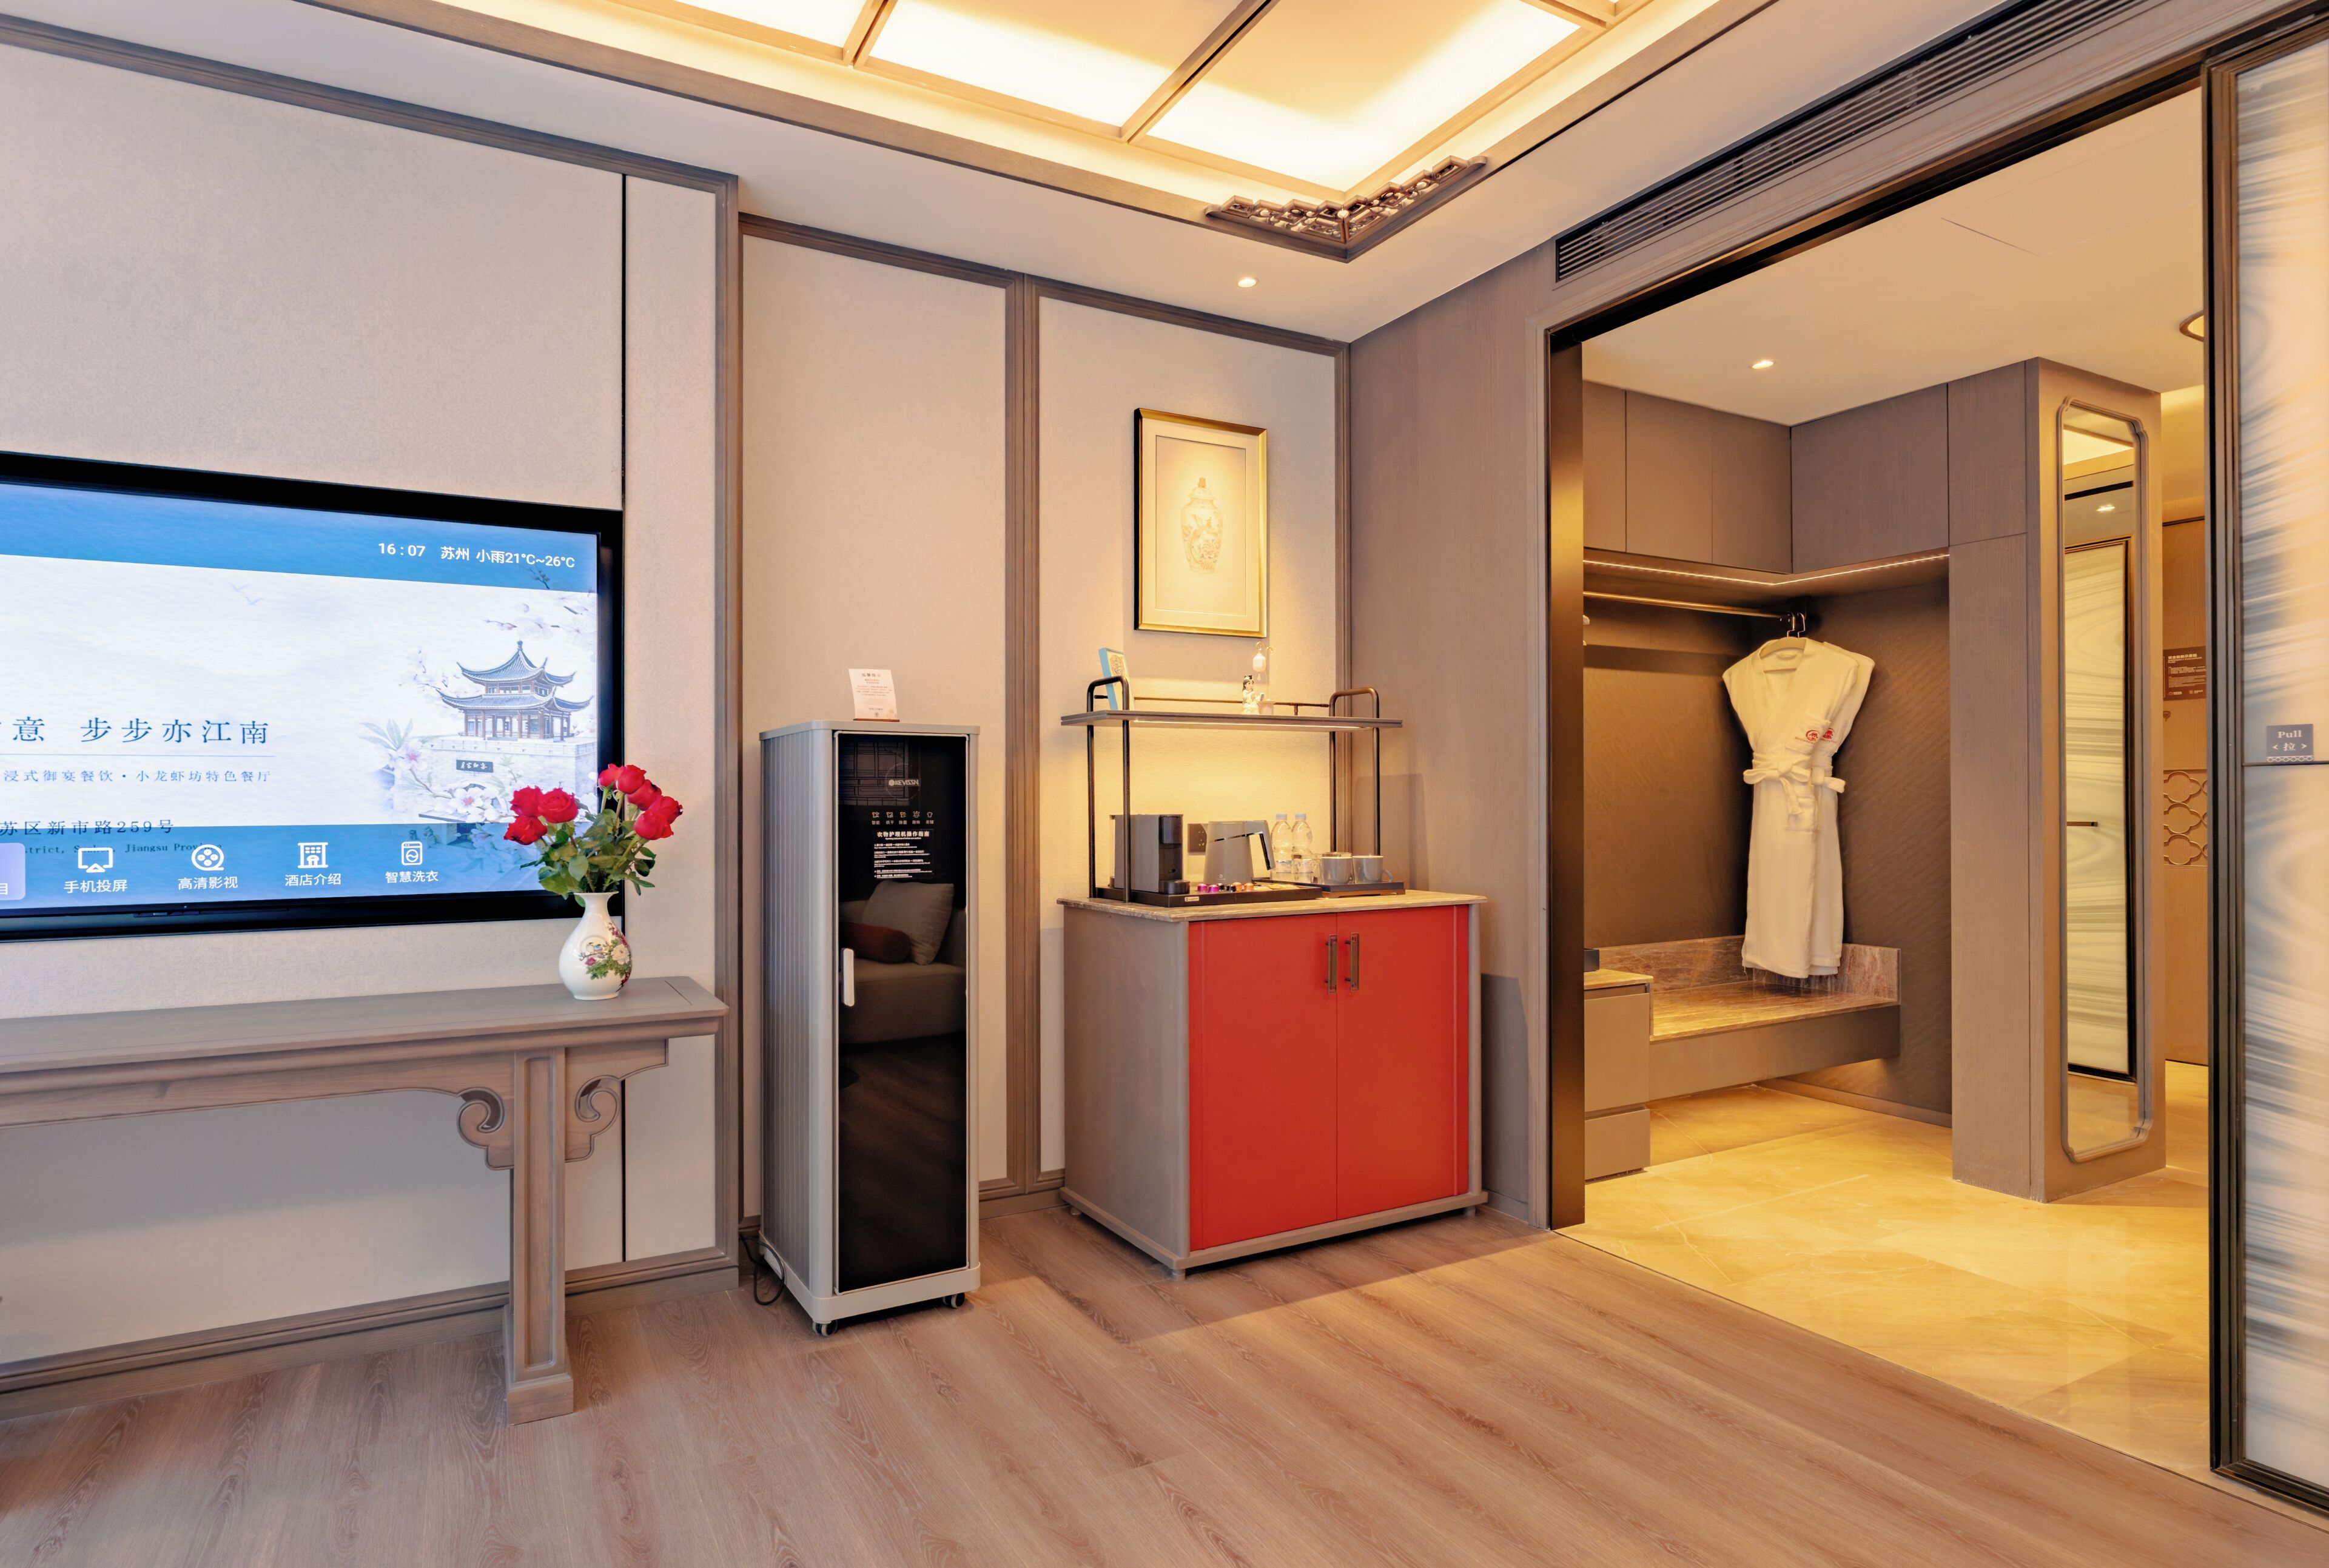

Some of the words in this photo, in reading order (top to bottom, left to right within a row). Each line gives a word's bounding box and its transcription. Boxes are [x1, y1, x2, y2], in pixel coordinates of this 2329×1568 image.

[440, 546, 469, 561] 苏州
[80, 716, 269, 744] 步步亦江南
[2277, 730, 2303, 738] Pull
[2283, 742, 2296, 752] 拉
[0, 819, 173, 836] 苏区新市路259号
[125, 844, 168, 852] Jiangsu
[178, 876, 238, 890] 高清影视
[284, 873, 341, 887] 酒店介绍
[385, 870, 439, 884] 智慧洗衣
[63, 880, 128, 894] 手机投屏
